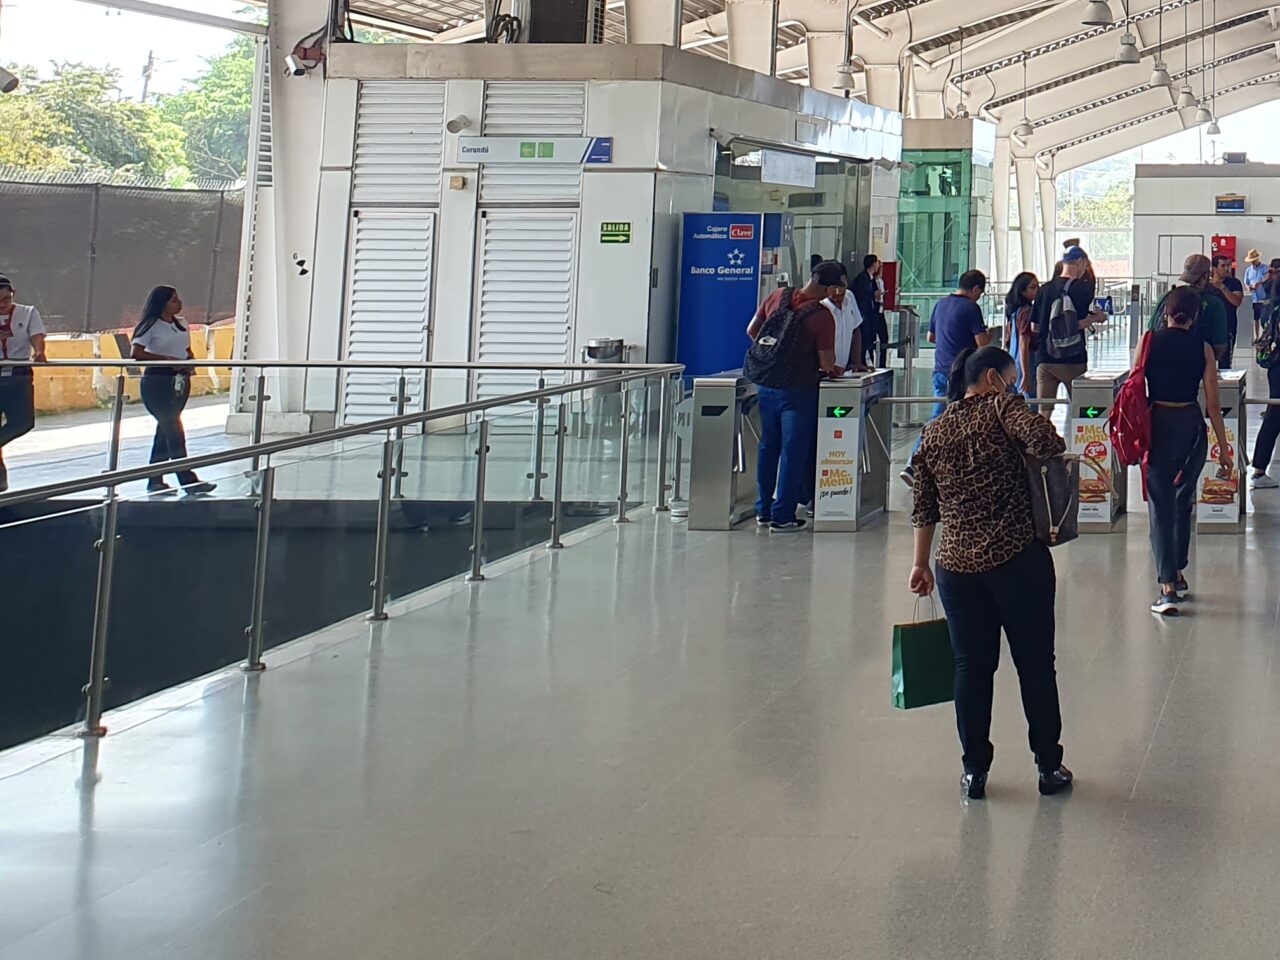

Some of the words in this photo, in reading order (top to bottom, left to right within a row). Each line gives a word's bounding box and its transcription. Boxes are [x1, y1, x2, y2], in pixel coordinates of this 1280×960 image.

[602, 223, 629, 231] SALIDA
[706, 225, 728, 233] Cajero
[731, 228, 752, 237] Clave
[690, 266, 716, 275] Banco
[717, 266, 754, 275] General
[828, 450, 847, 458] HOY
